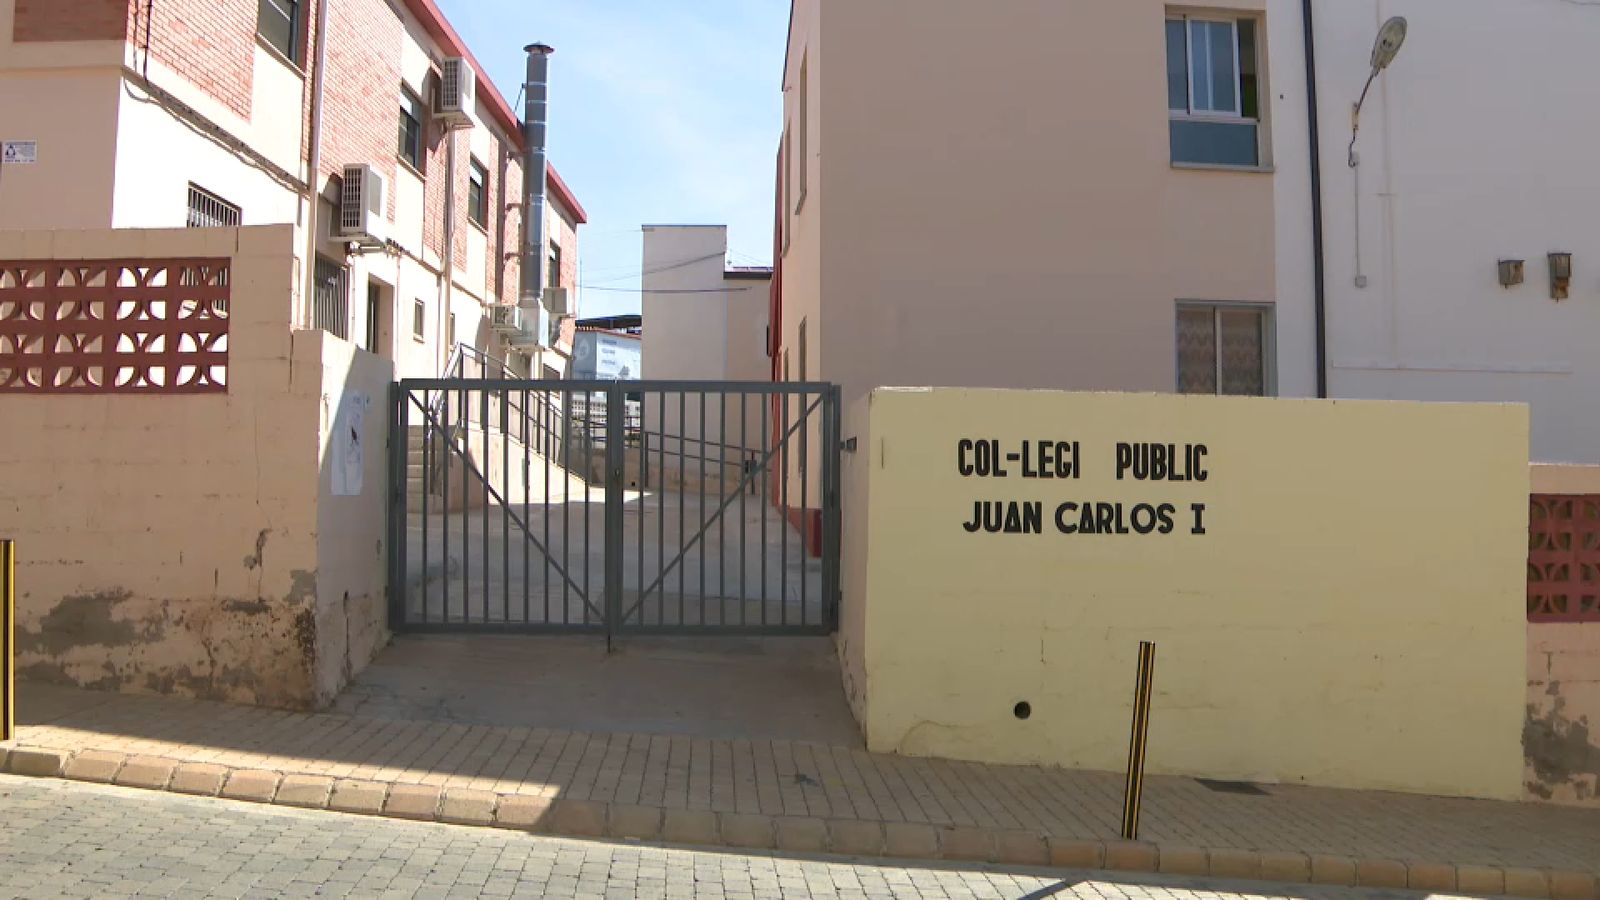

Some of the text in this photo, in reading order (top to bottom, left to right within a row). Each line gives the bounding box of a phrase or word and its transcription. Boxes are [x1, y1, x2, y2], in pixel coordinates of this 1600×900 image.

[957, 437, 1209, 483] COL-LEGI PUBLIC
[962, 500, 1206, 536] JUAN CARLOS I
